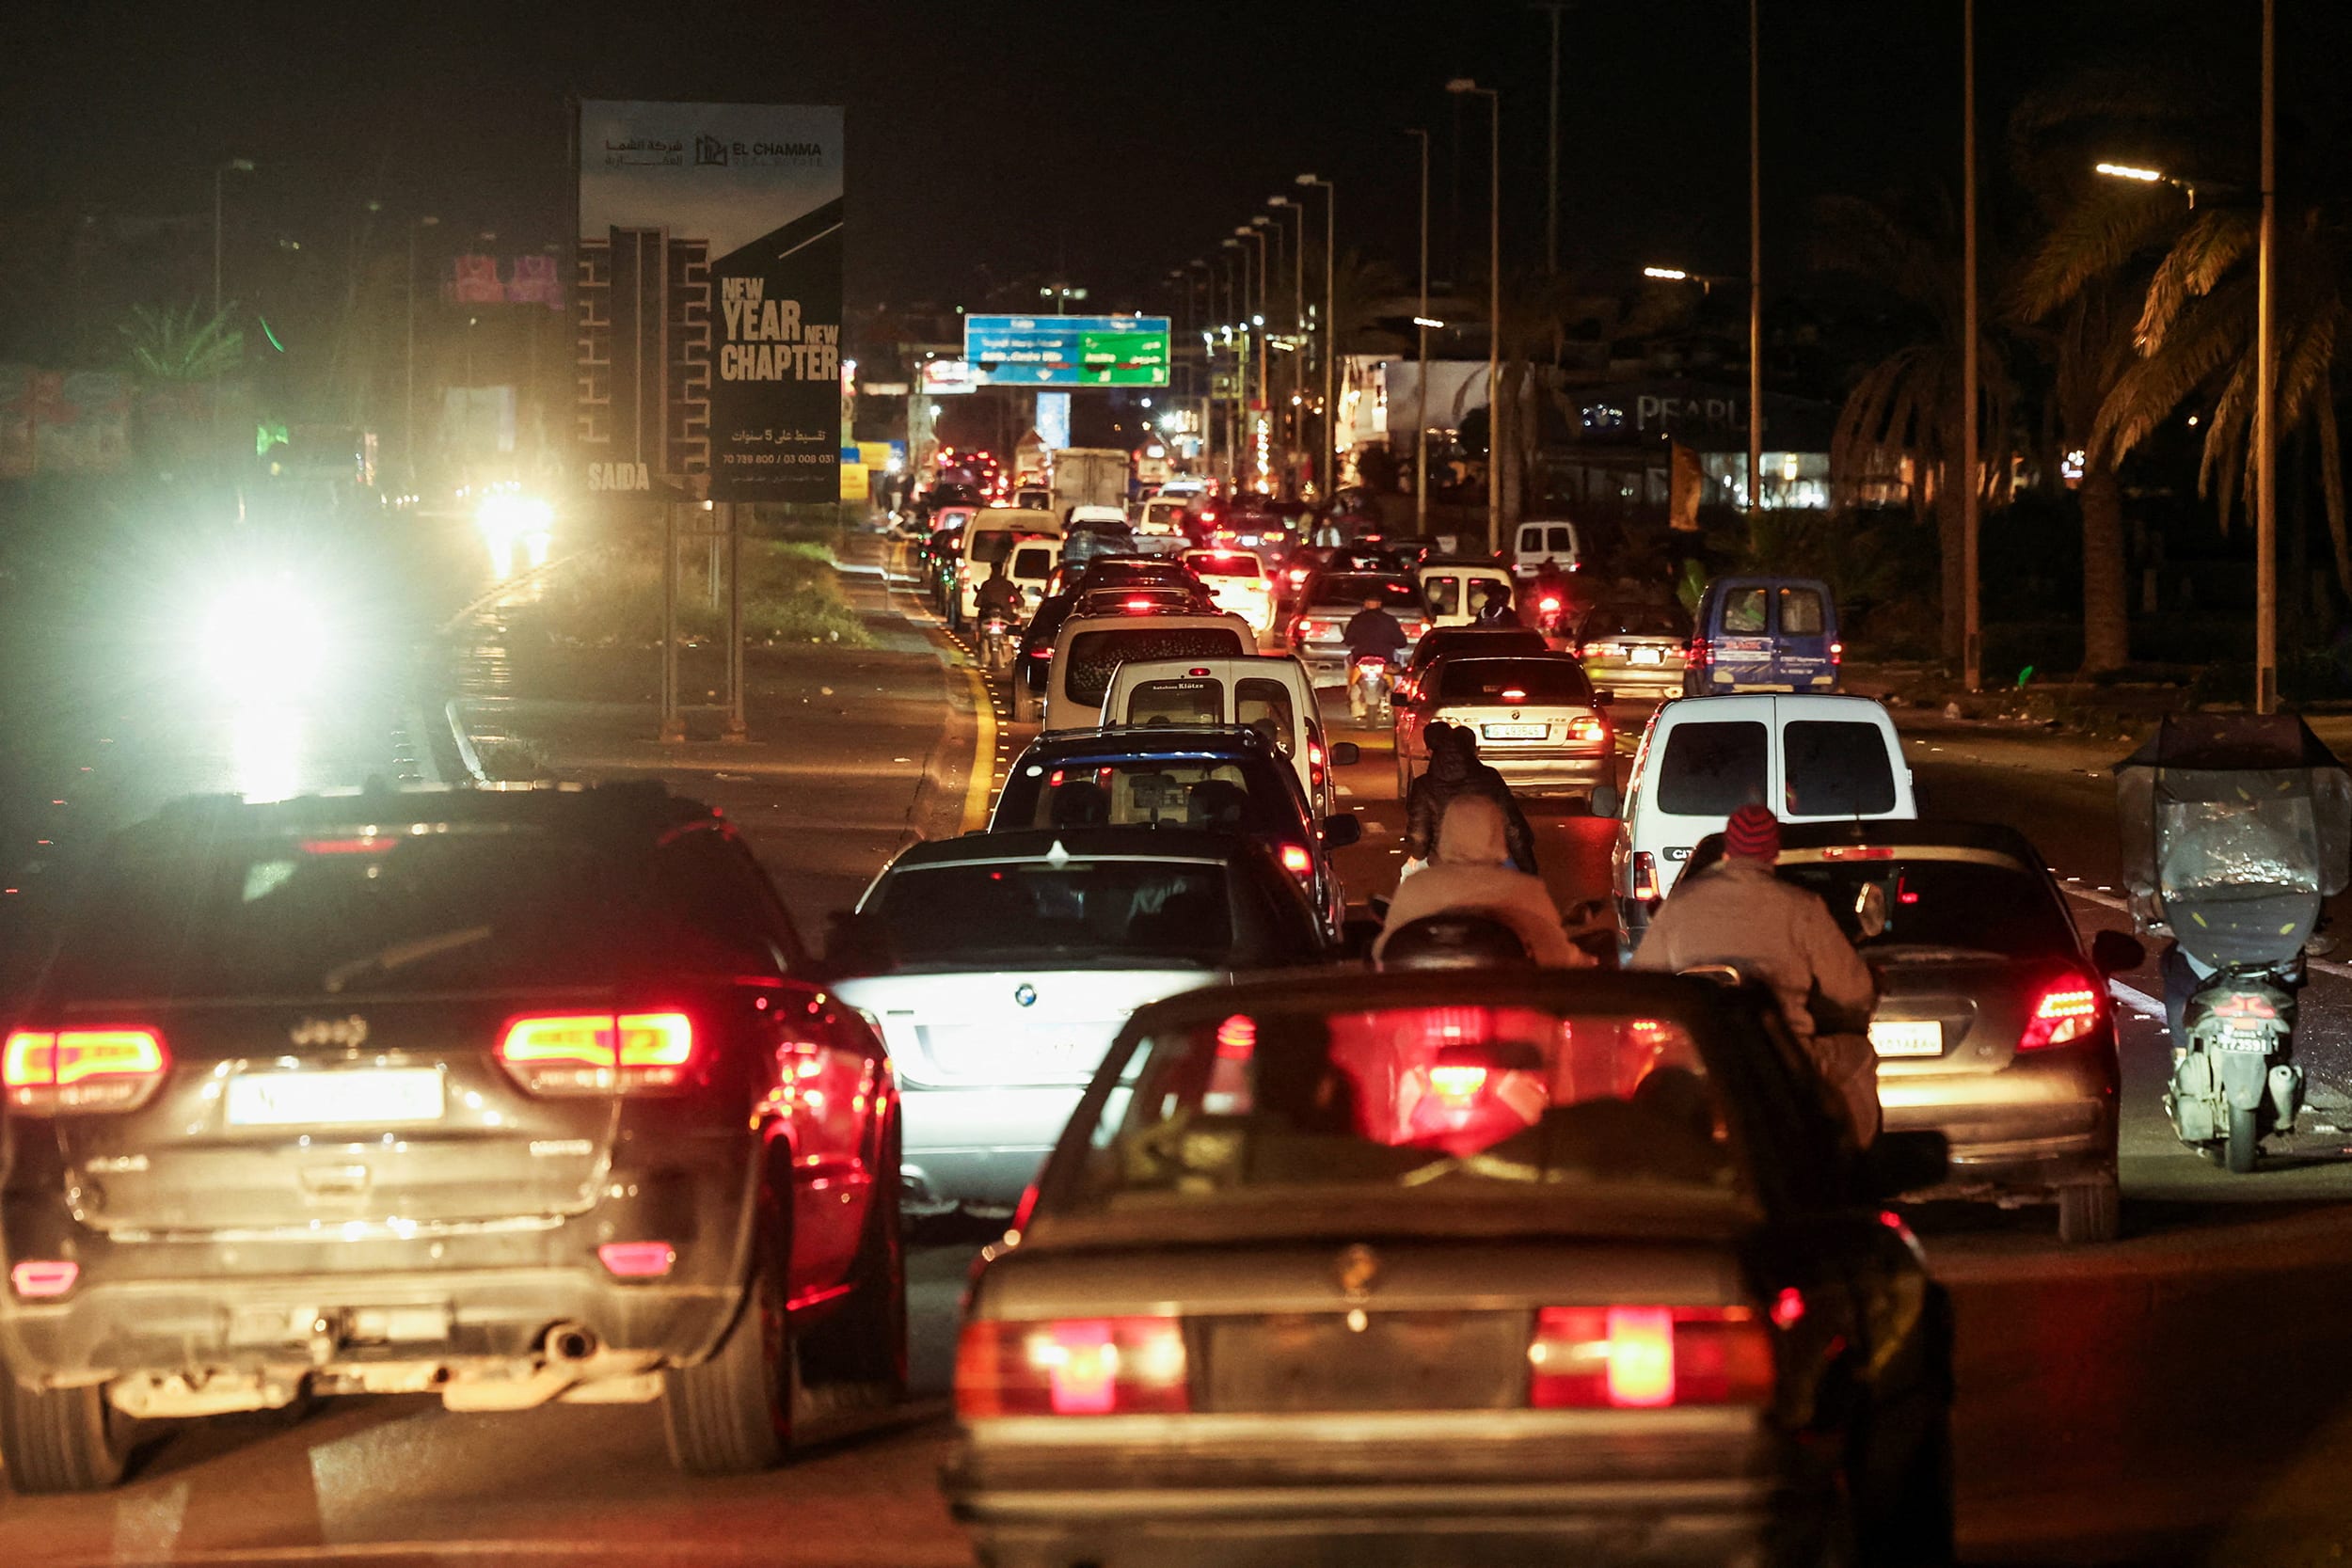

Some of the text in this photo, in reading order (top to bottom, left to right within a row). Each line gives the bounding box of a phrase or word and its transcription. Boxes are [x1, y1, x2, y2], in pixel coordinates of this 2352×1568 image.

[733, 143, 822, 156] EL CHAMMA
[722, 277, 764, 300] NEW
[722, 299, 839, 345] YEAR NEW
[721, 344, 839, 381] CHAPTER
[1636, 395, 1749, 432] PEARL
[731, 430, 763, 444] سنوات
[764, 429, 772, 440] 5
[773, 429, 792, 445] على
[723, 454, 735, 464] 70
[784, 454, 796, 464] 03
[587, 462, 650, 490] SAIDA
